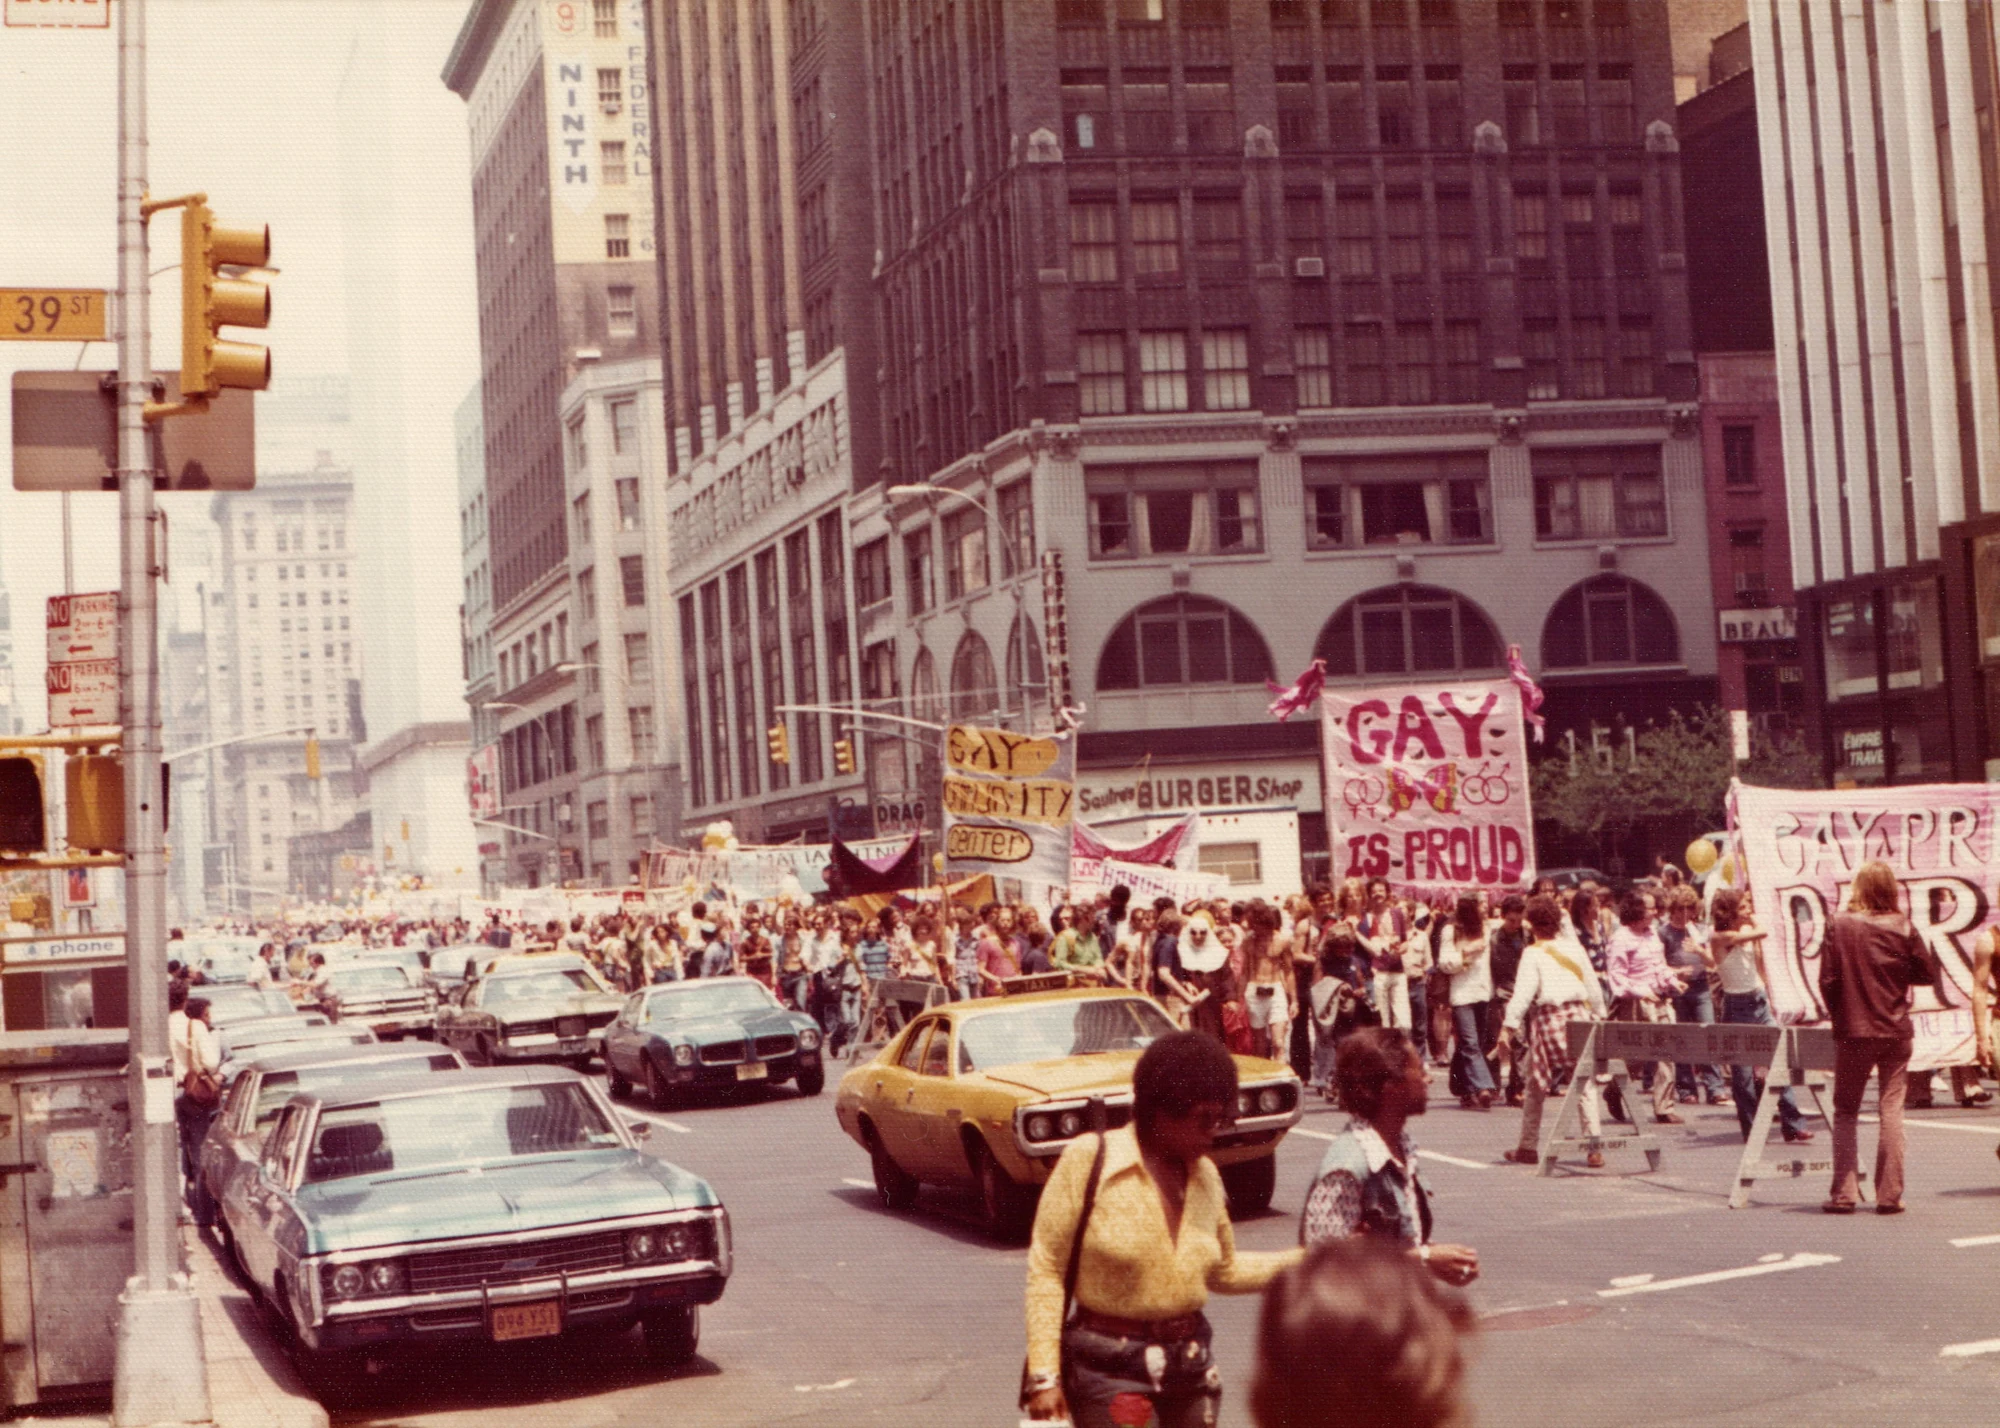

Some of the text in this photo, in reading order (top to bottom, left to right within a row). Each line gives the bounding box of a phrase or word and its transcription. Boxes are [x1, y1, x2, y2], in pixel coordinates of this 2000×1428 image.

[559, 64, 588, 184] NINTH
[628, 46, 651, 177] FEDERAL
[14, 295, 93, 334] 39 ST
[48, 599, 115, 623] NO PARKING
[48, 666, 70, 689] NO
[1346, 691, 1498, 765] GAY
[949, 727, 1032, 770] GAY
[1137, 775, 1255, 809] BURGER
[1254, 776, 1303, 802] Shop
[877, 803, 925, 823] DRAG
[1345, 824, 1525, 885] IS PROUD
[1771, 809, 1890, 876] GAY
[50, 940, 115, 957] phone
[1024, 979, 1051, 991] TAXI
[1607, 1140, 1627, 1150] DEPT
[1808, 1161, 1831, 1171] DEPT
